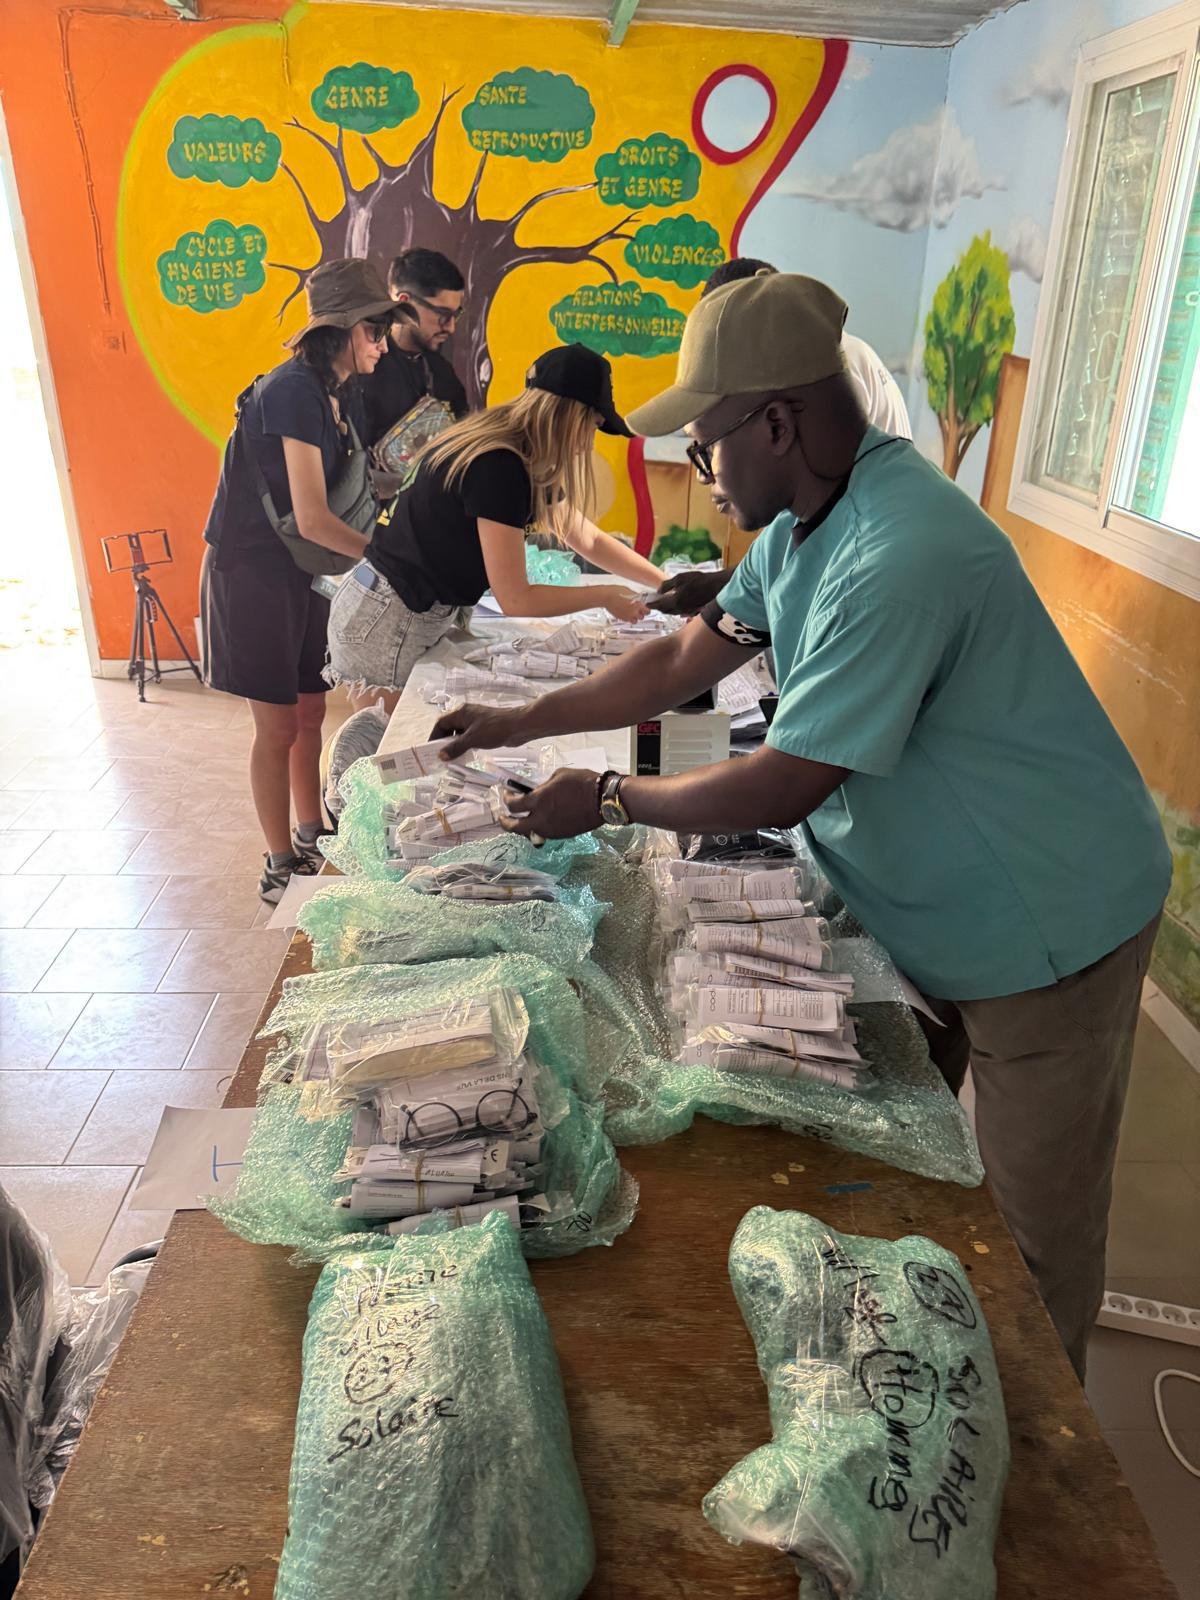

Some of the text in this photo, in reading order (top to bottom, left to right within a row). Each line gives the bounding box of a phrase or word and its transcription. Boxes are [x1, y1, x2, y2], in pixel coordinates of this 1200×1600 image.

[324, 85, 390, 109] GENRE
[479, 85, 528, 105] SANTE
[471, 129, 585, 150] REPRODUCTIVE
[183, 141, 267, 164] VALEURS
[618, 145, 680, 167] DROITS
[600, 176, 683, 198] ET GENRE
[185, 233, 264, 257] CYCLE ET
[633, 244, 726, 267] VIOLENCES
[166, 260, 247, 281] HYGIENE
[176, 282, 237, 303] DE VIE
[572, 288, 642, 306] RELATIONS
